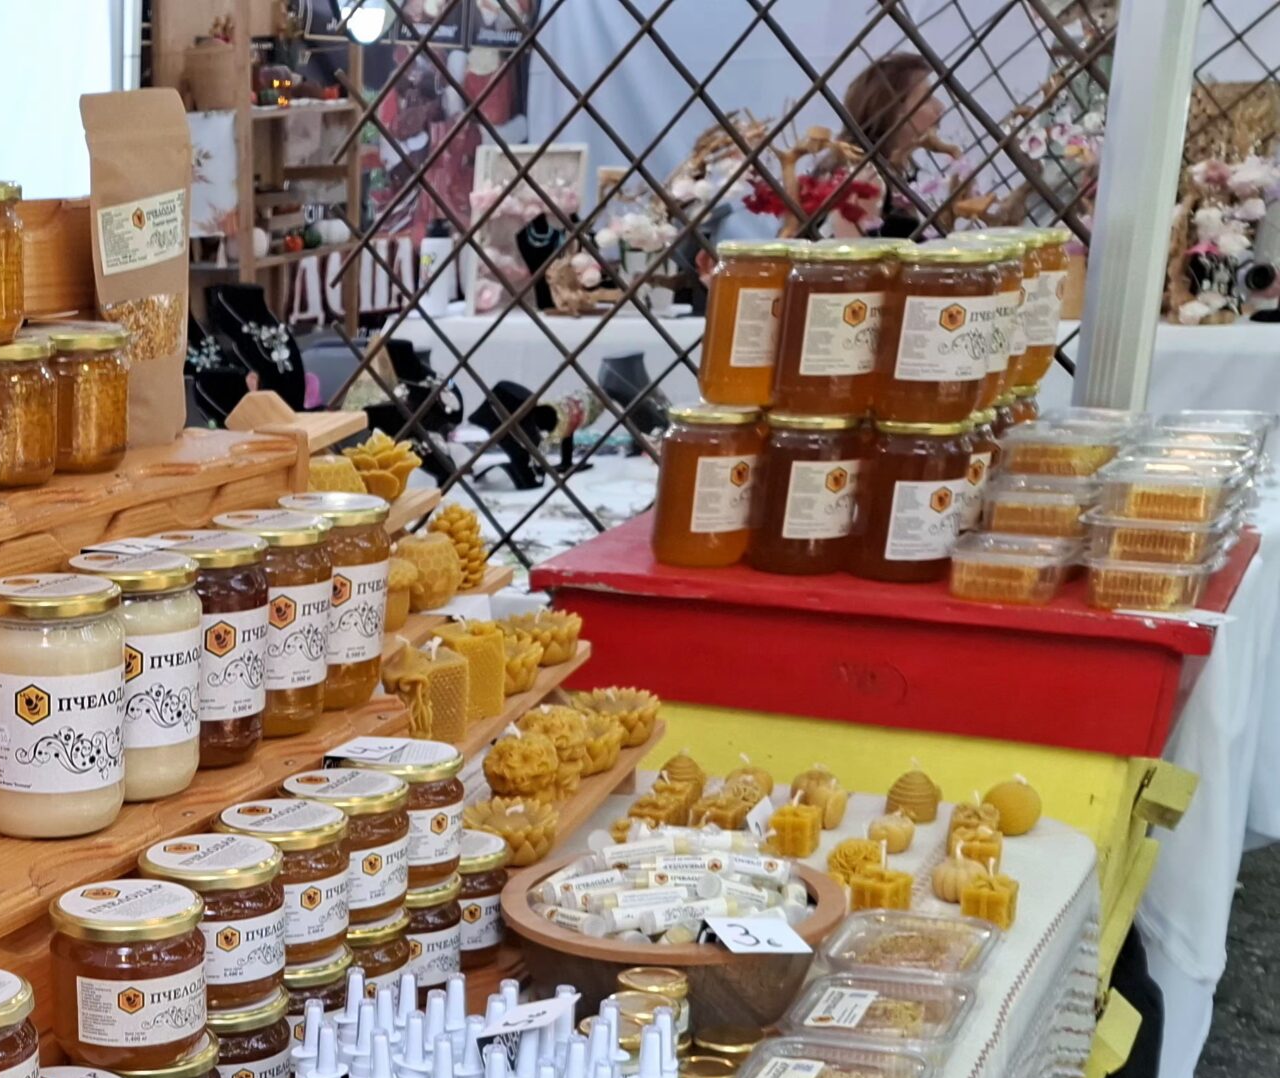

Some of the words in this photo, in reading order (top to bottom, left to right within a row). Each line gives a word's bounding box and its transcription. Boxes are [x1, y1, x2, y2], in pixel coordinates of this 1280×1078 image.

[356, 579, 386, 595] ПЧЕЛ
[56, 686, 124, 712] ПЧЕЛОД
[245, 918, 286, 943] ПЧЕЛОД
[149, 975, 206, 1005] ПЧЕЛОДА
